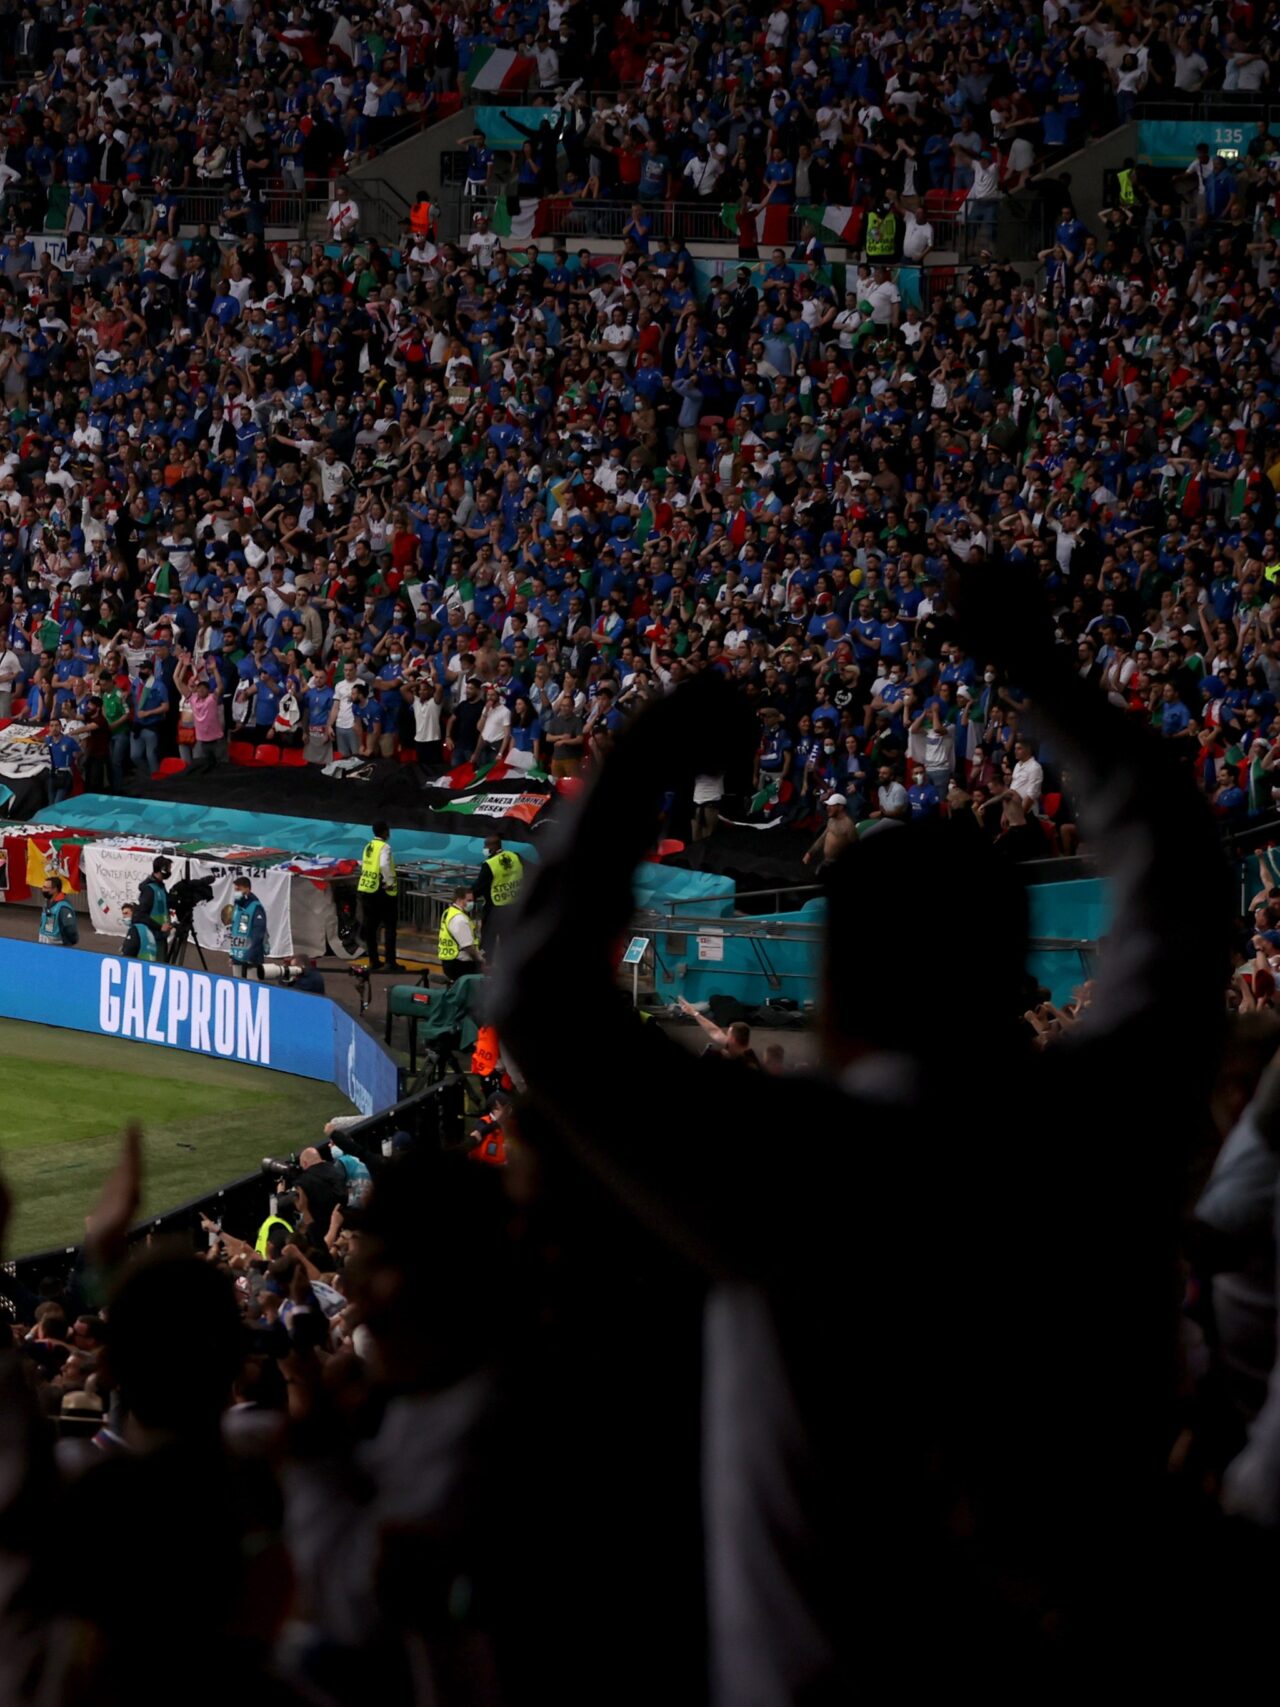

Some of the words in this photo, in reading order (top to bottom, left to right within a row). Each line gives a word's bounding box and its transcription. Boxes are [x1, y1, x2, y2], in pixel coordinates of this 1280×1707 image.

[1215, 128, 1243, 144] 135
[211, 866, 243, 878] GATE
[246, 868, 267, 878] 121
[99, 957, 270, 1065] GAZPROM
